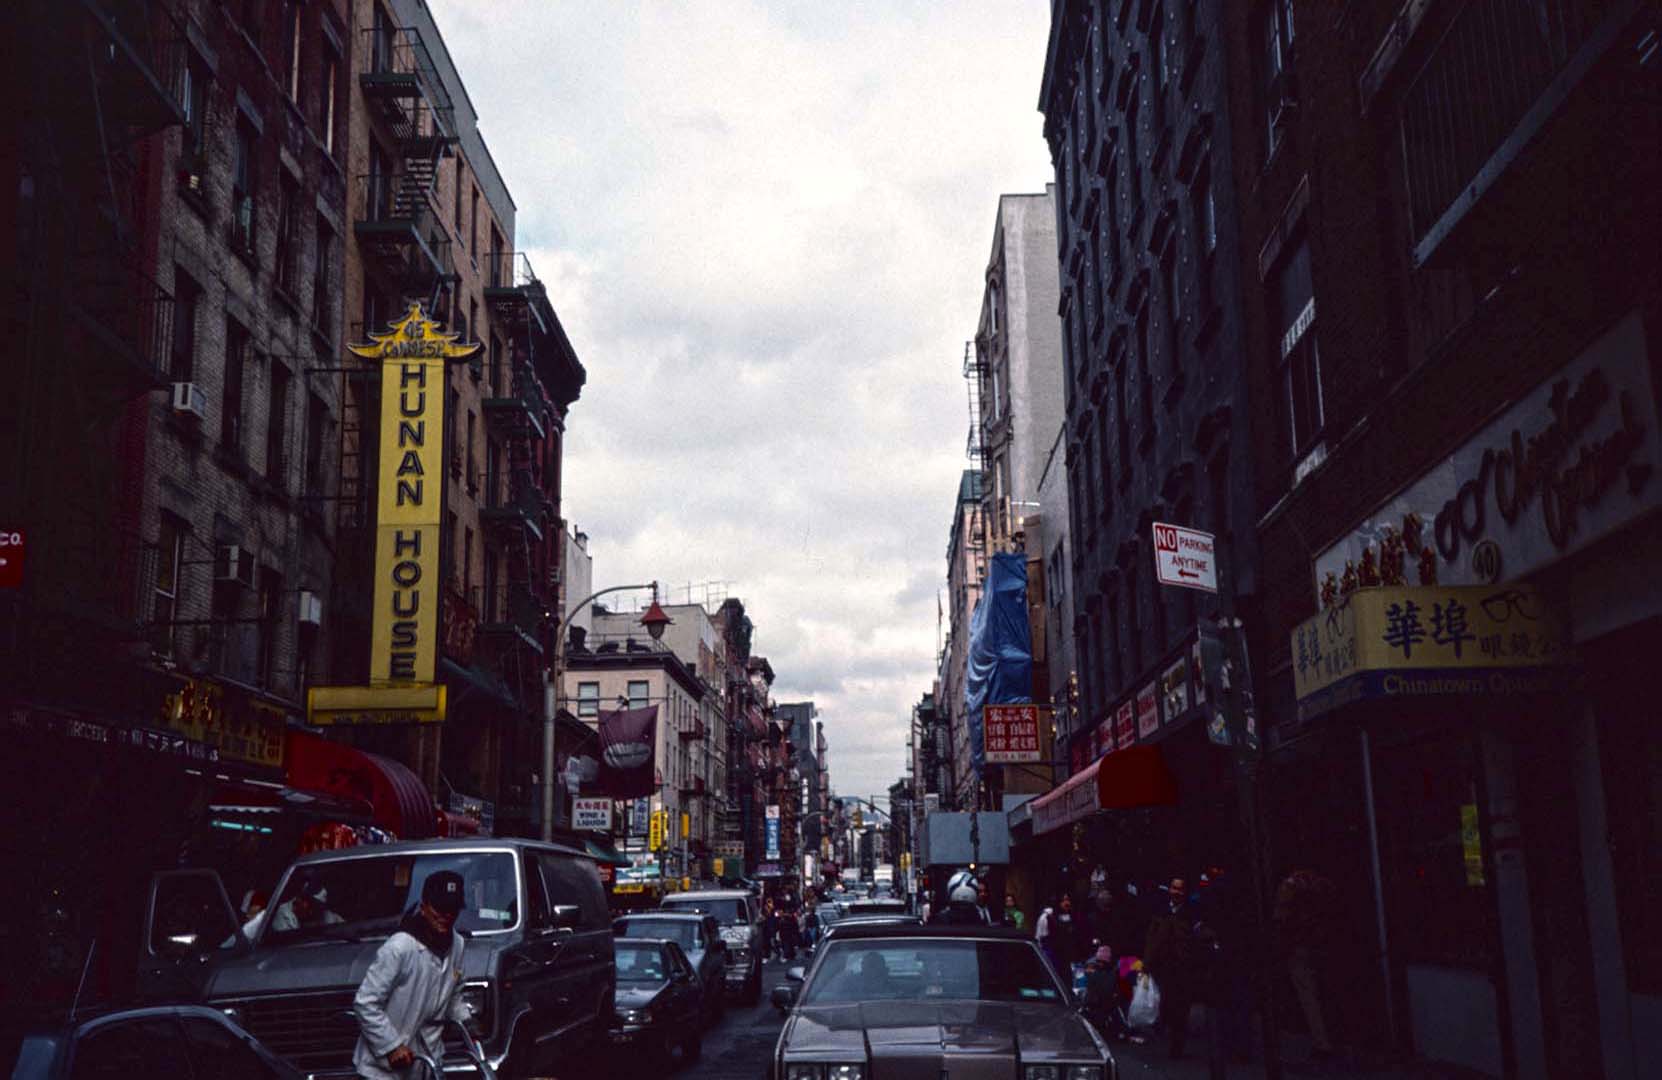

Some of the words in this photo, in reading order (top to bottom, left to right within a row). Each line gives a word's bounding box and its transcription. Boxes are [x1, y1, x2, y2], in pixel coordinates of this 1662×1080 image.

[396, 363, 426, 507] HUNAN
[1156, 528, 1176, 550] NO
[1179, 536, 1213, 555] PARKING
[1171, 555, 1209, 574] ANYTIME
[390, 530, 421, 680] HOUSE
[1382, 598, 1475, 660] 華埠
[1382, 674, 1482, 697] Chinatown
